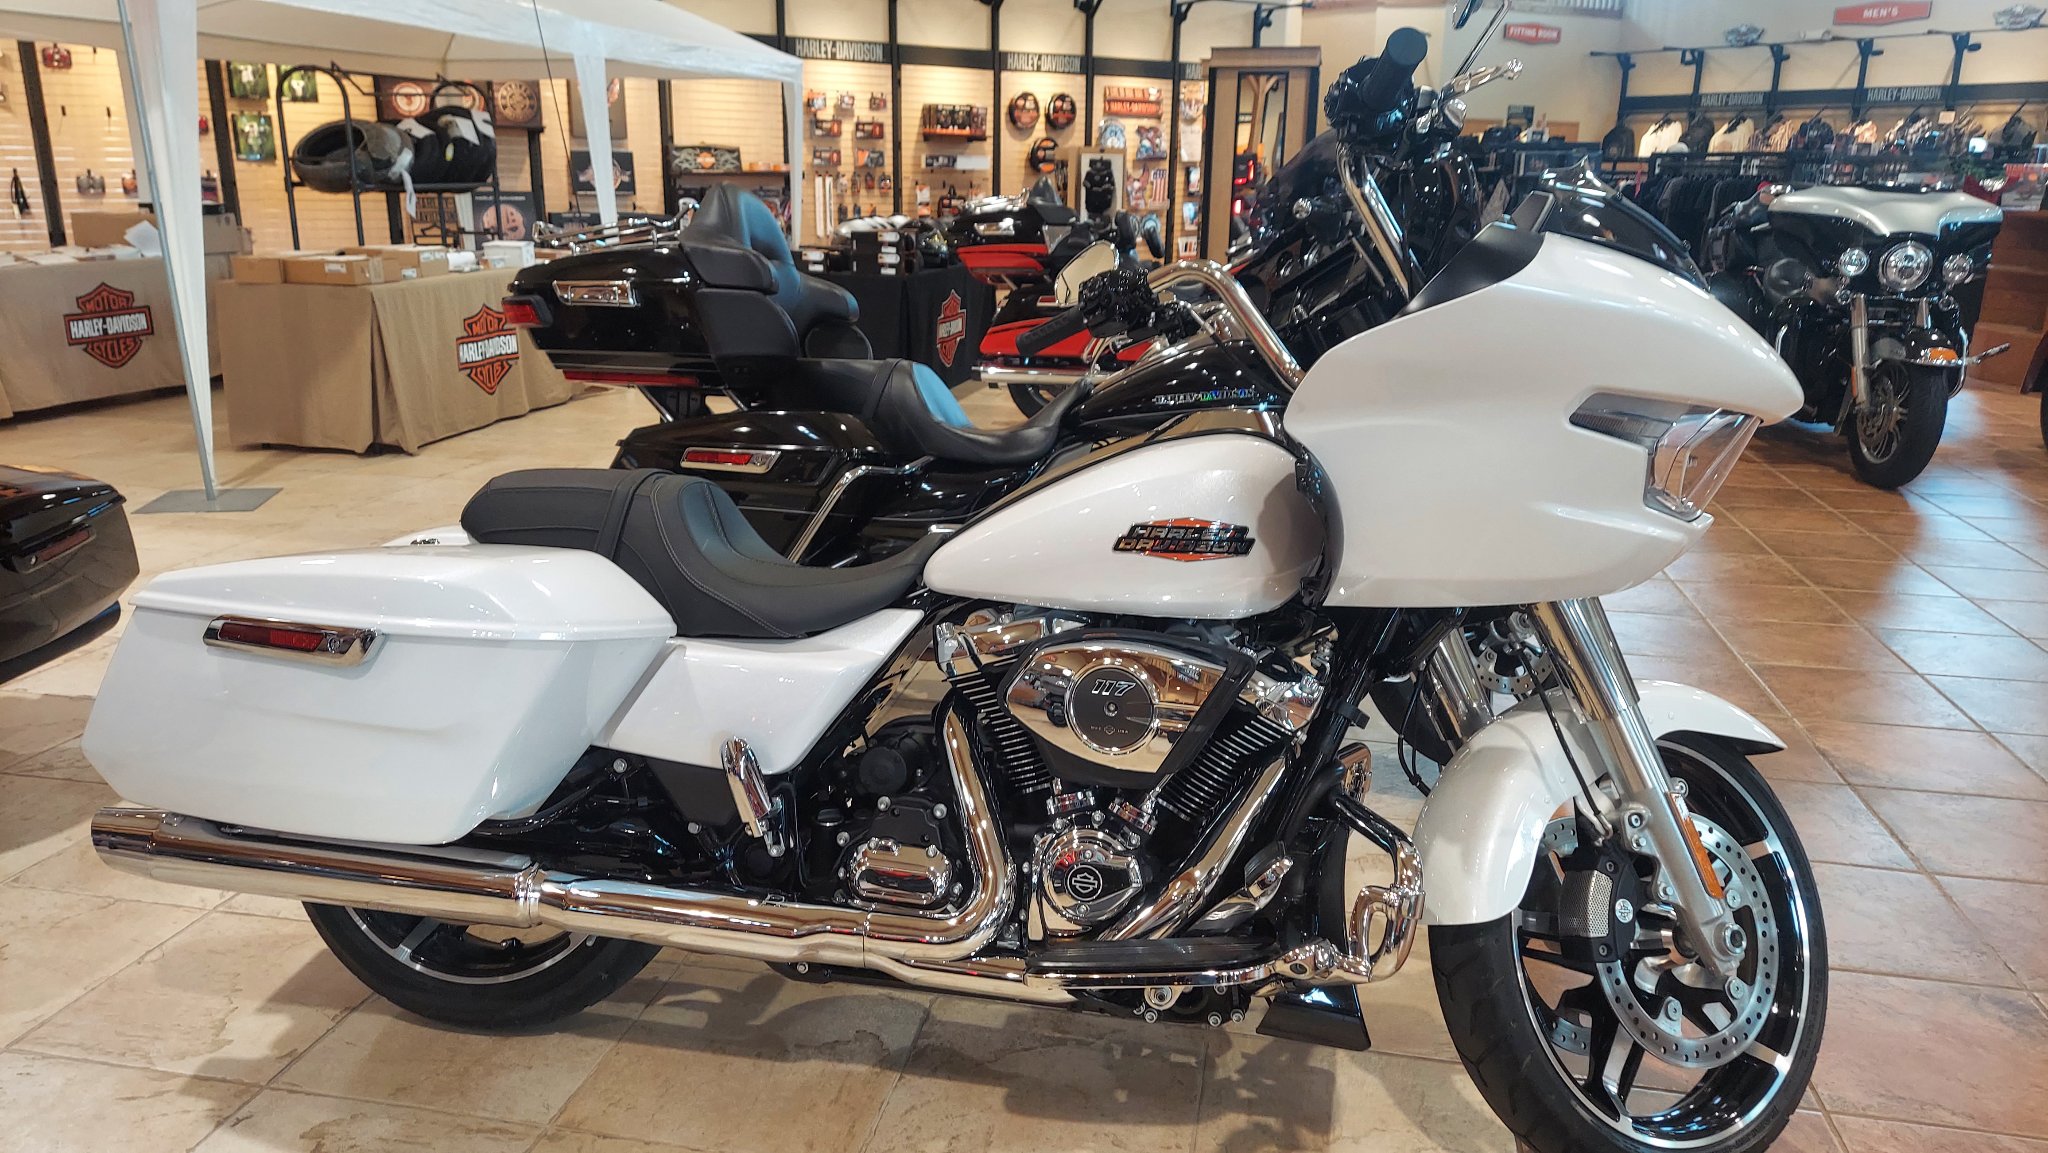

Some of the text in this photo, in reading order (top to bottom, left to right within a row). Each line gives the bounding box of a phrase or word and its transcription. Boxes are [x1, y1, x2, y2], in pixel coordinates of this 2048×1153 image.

[1863, 7, 1898, 18] MEN'S
[795, 38, 884, 61] HARLEY-DAVIDSON
[1007, 52, 1081, 73] HARLEY-DAVIDSON
[1867, 86, 1942, 102] HARLEY-DAVIDSON
[85, 291, 127, 312] MOTOR
[70, 312, 148, 339] HARLEY-DAVIDSON
[93, 338, 135, 361] CYCLES
[1132, 526, 1249, 540] HARLEY
[1118, 538, 1253, 553] DAVIDSON
[1092, 679, 1136, 697] 117
